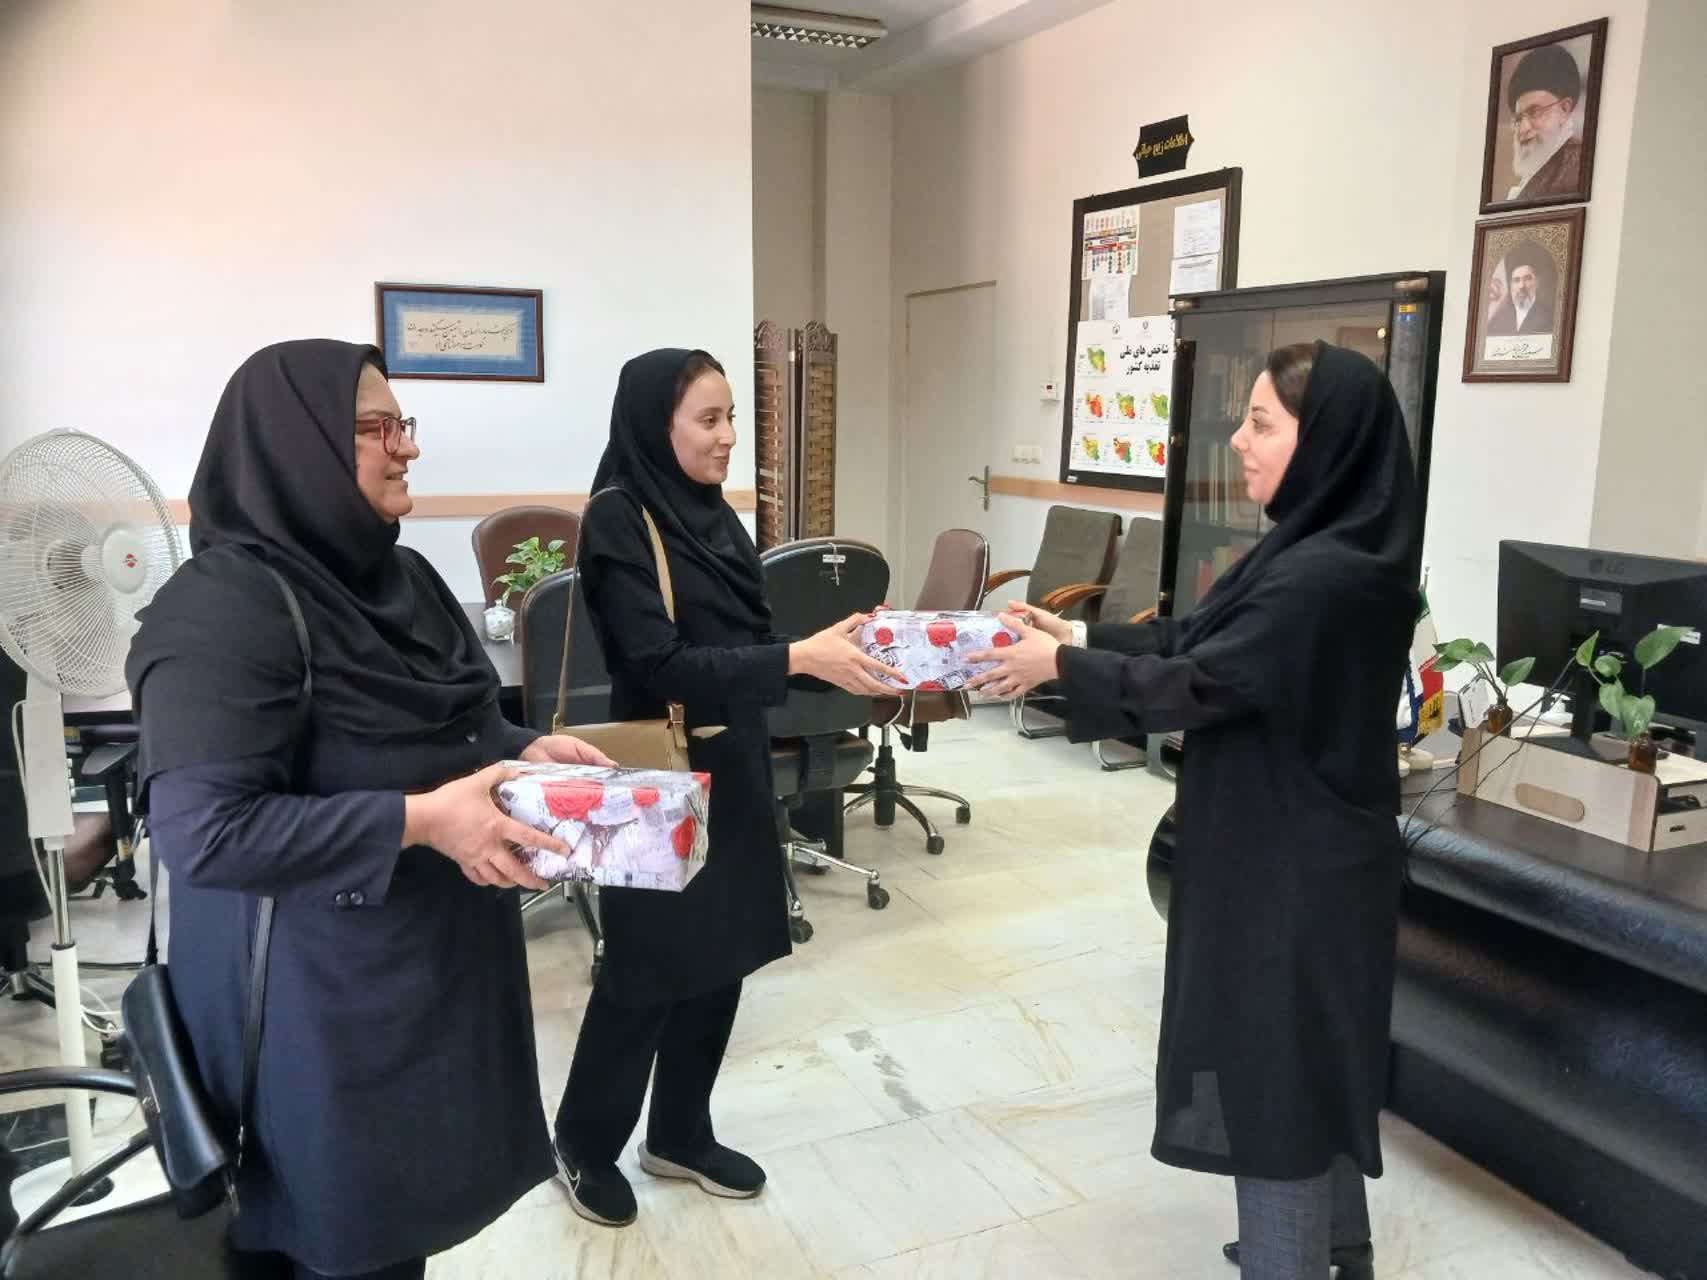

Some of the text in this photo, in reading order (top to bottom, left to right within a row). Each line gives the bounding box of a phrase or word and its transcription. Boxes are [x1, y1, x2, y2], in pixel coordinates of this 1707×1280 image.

[1132, 345, 1146, 359] های
[1147, 343, 1169, 358] شاخص
[1126, 360, 1161, 375] تغذیه کشور
